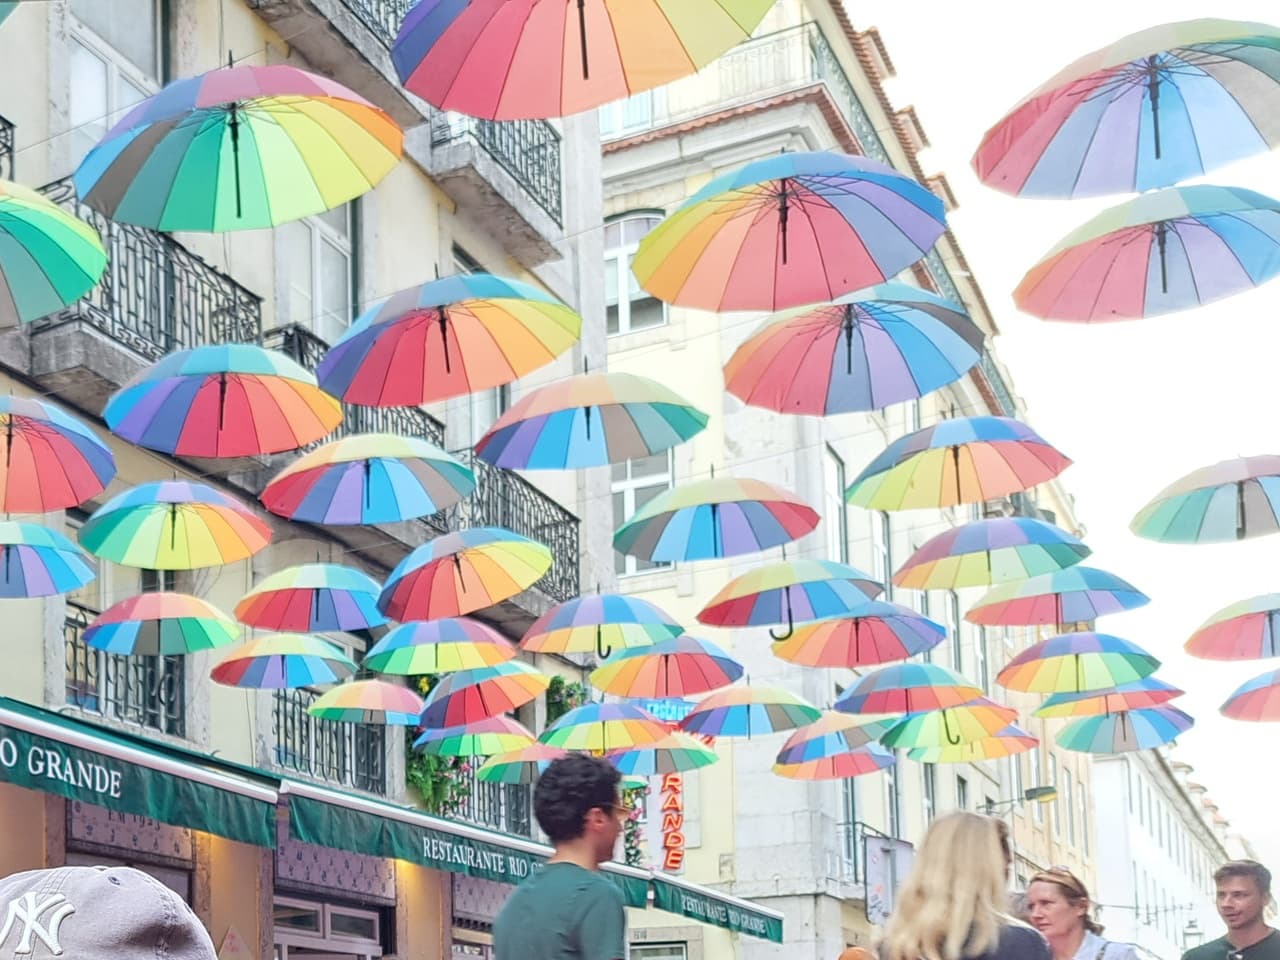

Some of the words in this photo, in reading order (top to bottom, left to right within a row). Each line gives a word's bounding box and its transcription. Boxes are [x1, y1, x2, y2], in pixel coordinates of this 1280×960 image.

[27, 744, 122, 799] GRANDE
[661, 773, 685, 871] RANDE
[423, 836, 505, 874] RESTAURANTE
[509, 856, 528, 878] RIO
